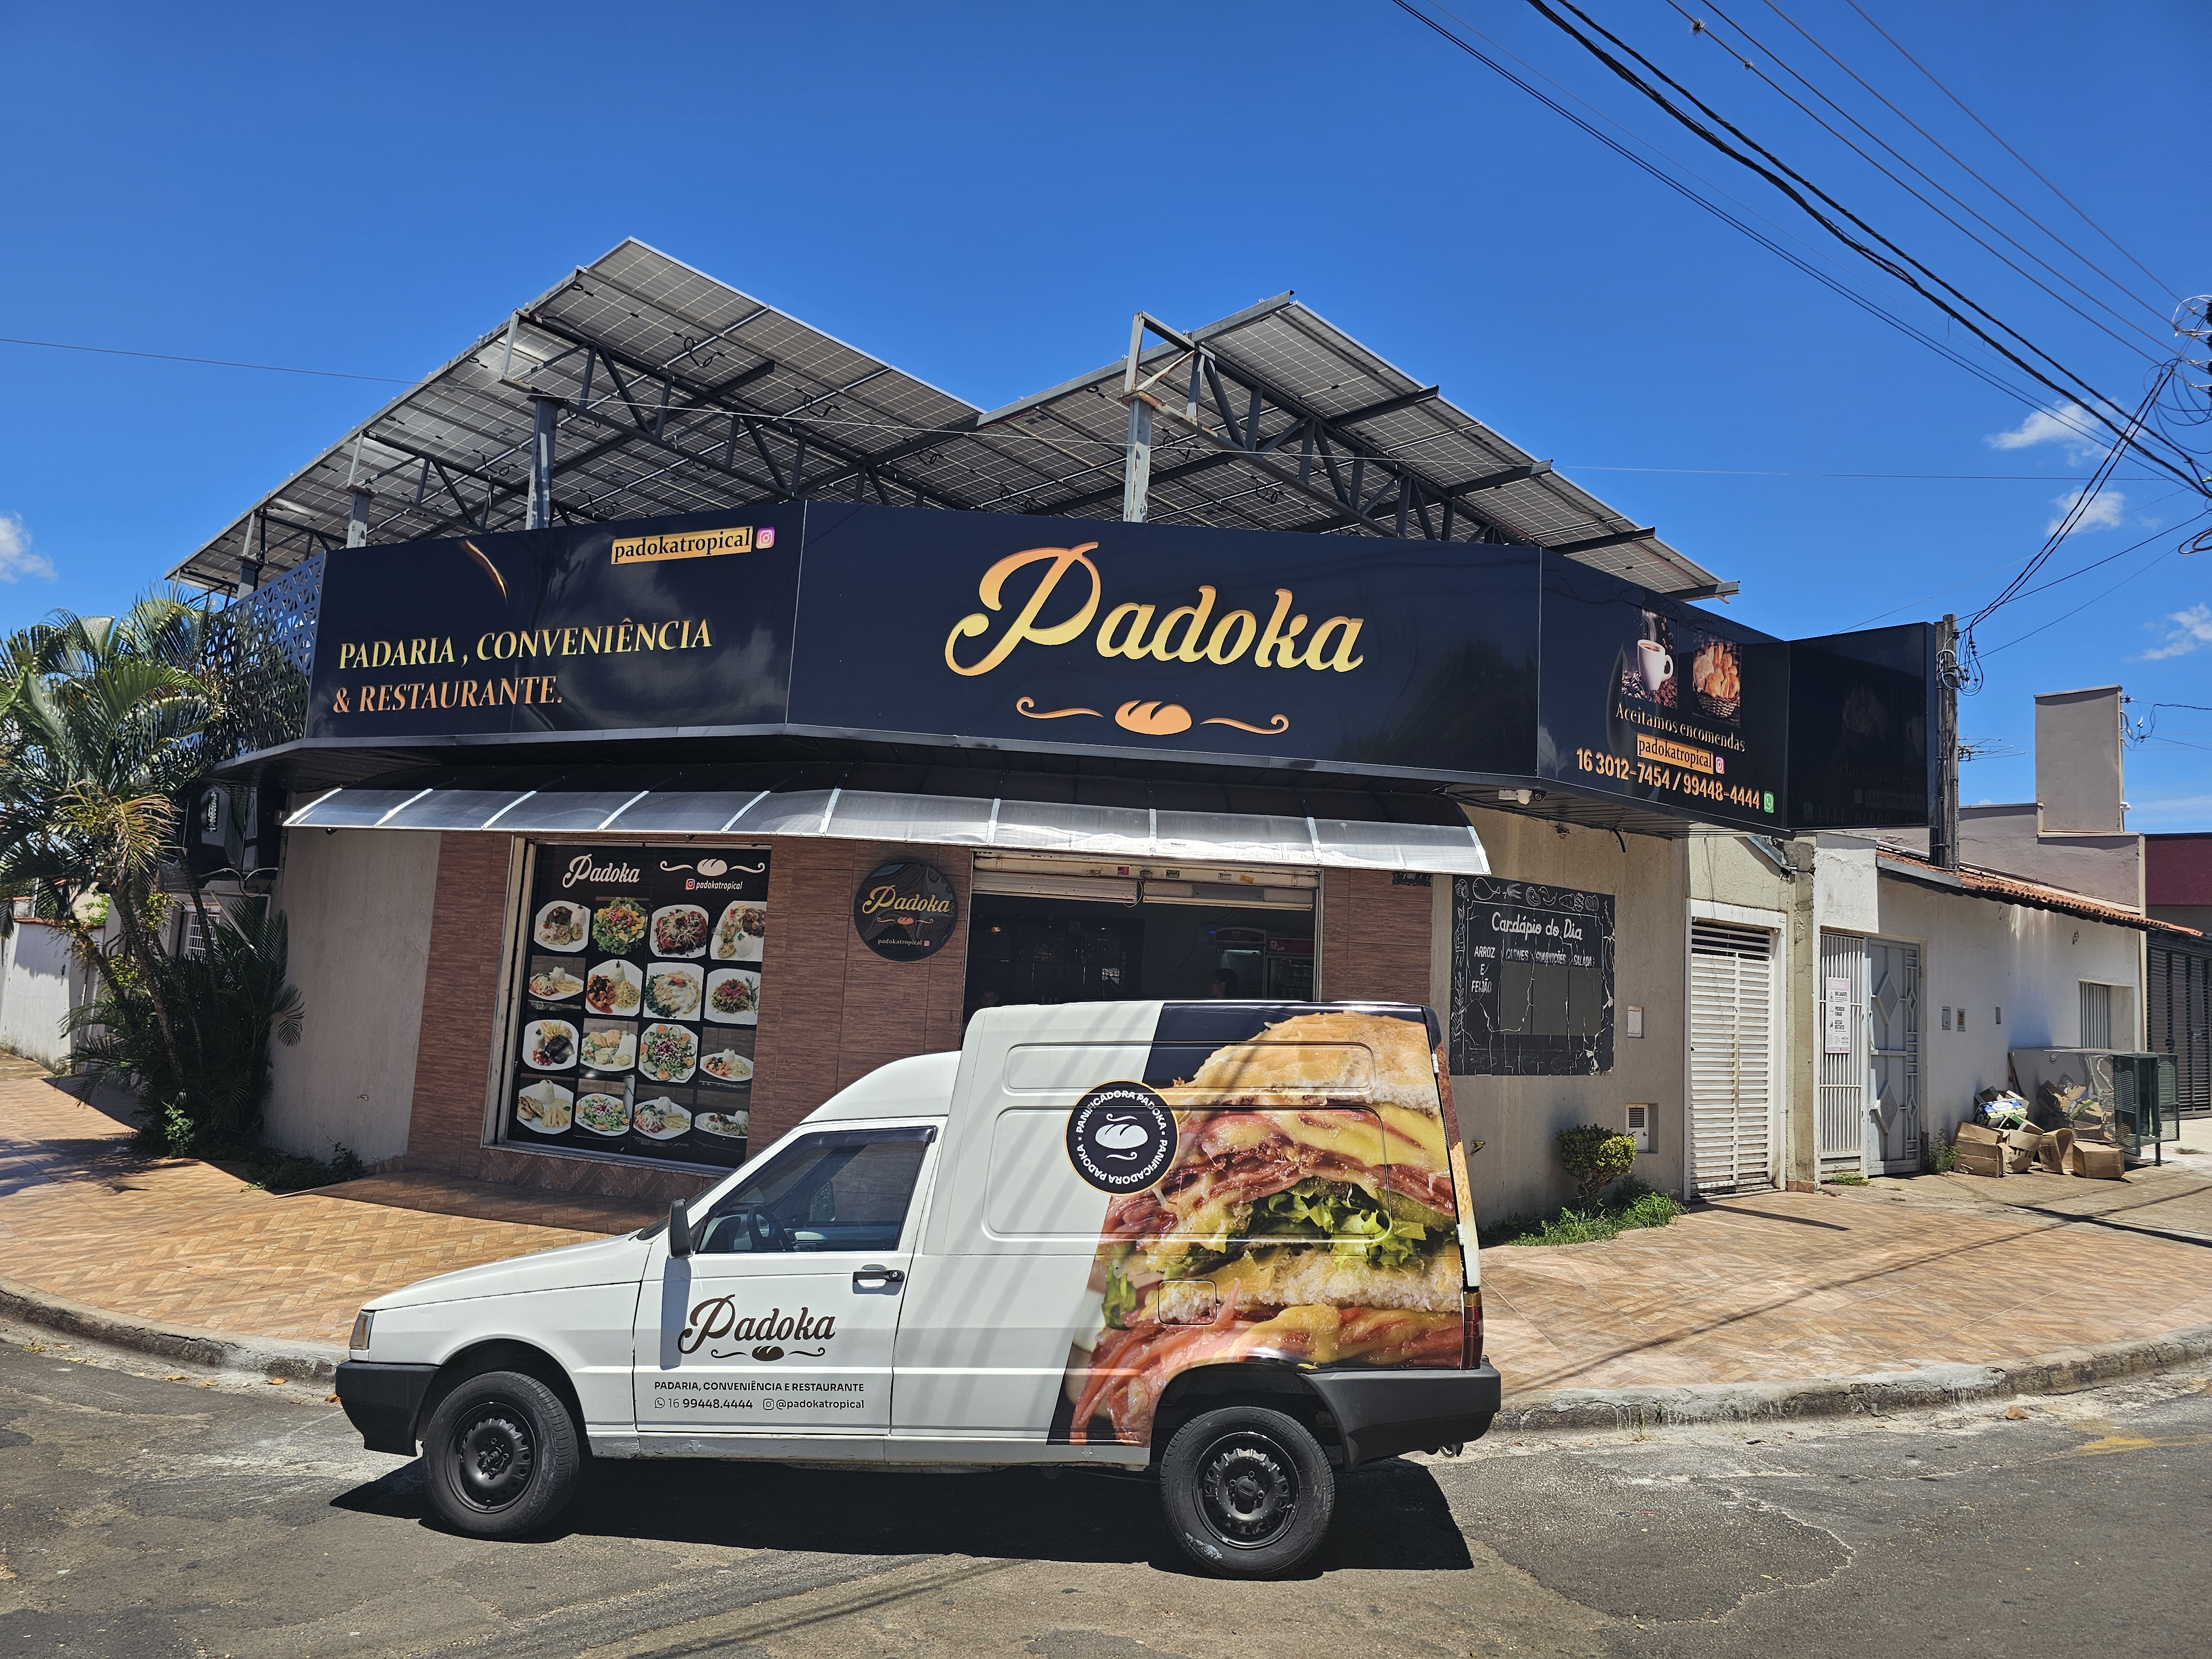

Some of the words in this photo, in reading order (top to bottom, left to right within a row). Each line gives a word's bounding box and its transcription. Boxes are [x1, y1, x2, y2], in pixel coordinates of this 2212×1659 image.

[614, 528, 751, 563] padokatropical
[944, 541, 1364, 676] Padoka
[476, 618, 712, 661] CONVENIÊNCIA
[333, 687, 351, 713] &
[359, 675, 563, 712] RESTAURANTE.
[1615, 702, 1678, 733] Aceitamos
[1680, 724, 1745, 752] encomendas
[1639, 738, 1712, 768] padokatropical
[1576, 747, 1593, 772] 16
[1595, 752, 1670, 789] 3012-7454
[1672, 771, 1682, 791] /
[1683, 773, 1760, 810] 99448-4444
[562, 853, 640, 888] Padoka
[696, 881, 743, 891] padokatropical
[862, 885, 950, 914] Padoka
[1491, 912, 1542, 941] Cardápio
[1545, 918, 1560, 936] do
[1563, 918, 1584, 941] Dia
[1474, 945, 1496, 958] ARROZ
[1480, 963, 1485, 975] E
[1471, 978, 1492, 993] FEIJÃO
[1076, 1090, 1136, 1133] PANIFICADORA
[1136, 1094, 1167, 1130] PADOKA
[1077, 1144, 1107, 1181] PADOKA
[1108, 1139, 1168, 1185] PANIFICADORA
[677, 1294, 836, 1354] Padoka
[654, 1381, 702, 1392] PADARIA,
[703, 1380, 782, 1391] CONVENIÊNCIA
[784, 1383, 790, 1391] E
[792, 1383, 864, 1392] RESTAURANTE
[668, 1399, 680, 1408] 16
[682, 1399, 754, 1409] 99448.4444
[776, 1399, 865, 1411] @padokatropical
